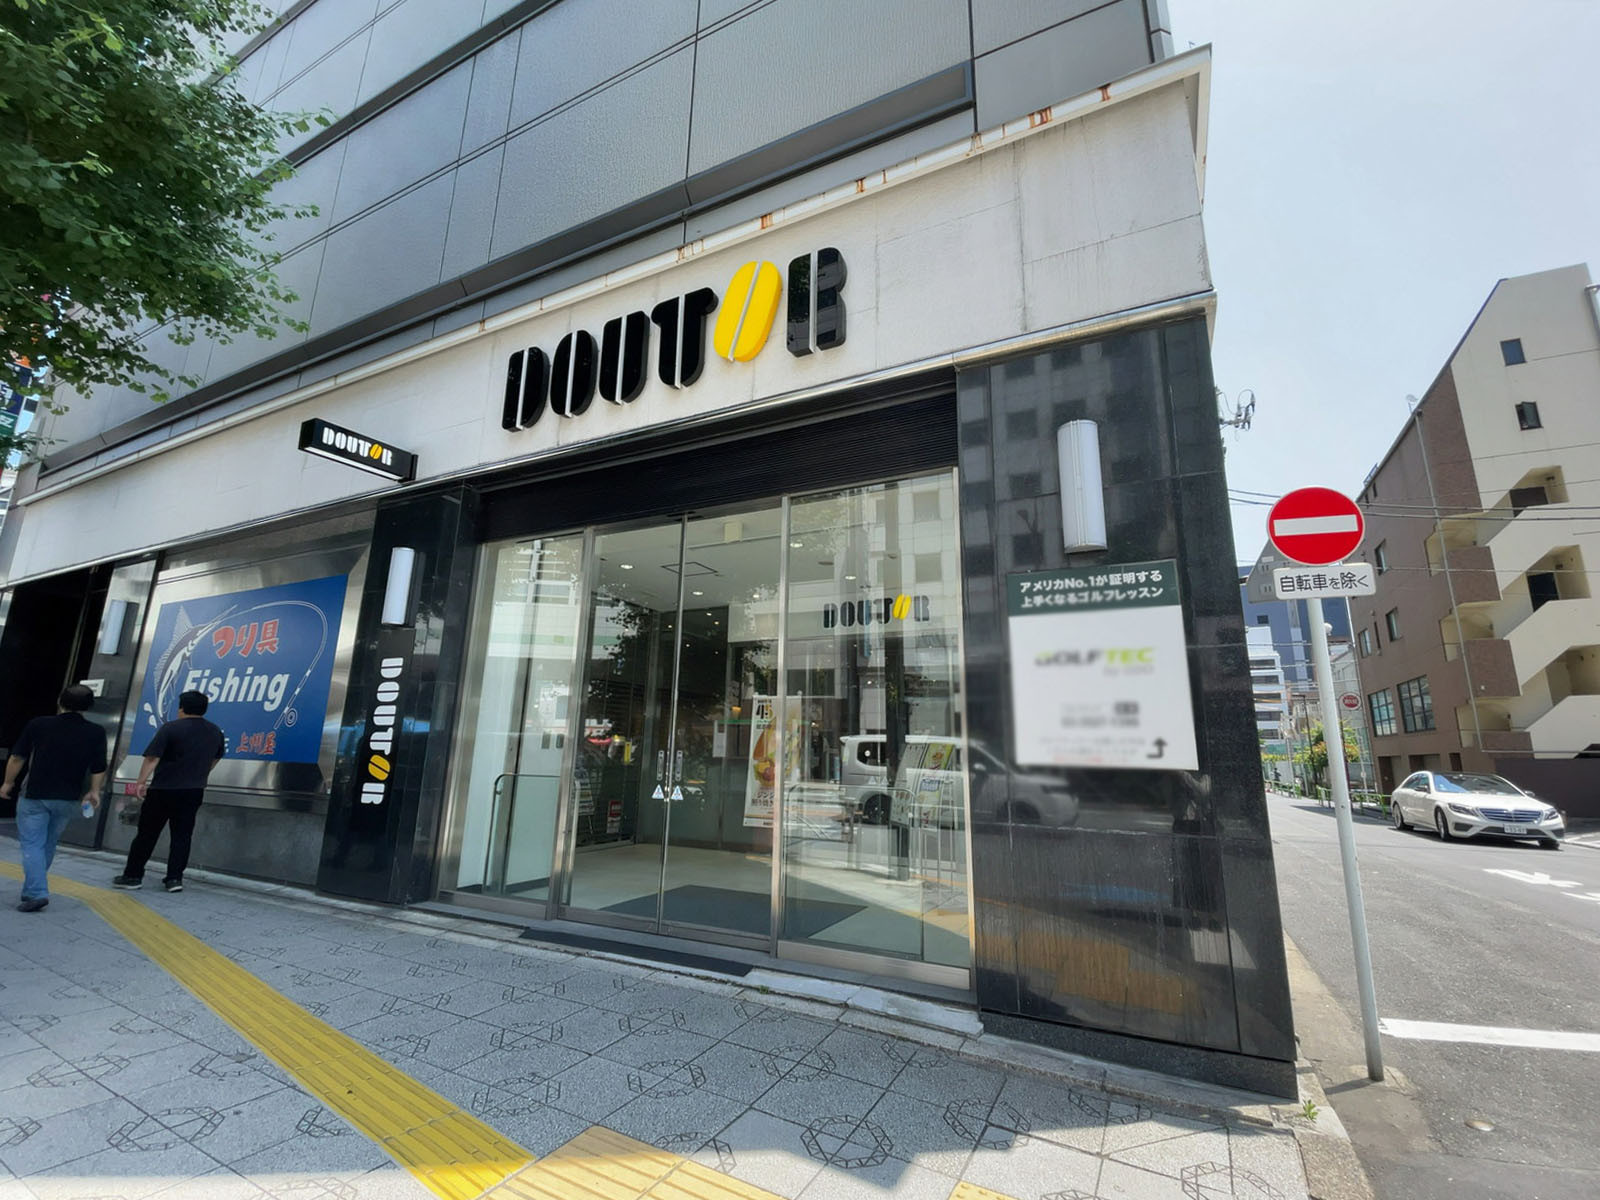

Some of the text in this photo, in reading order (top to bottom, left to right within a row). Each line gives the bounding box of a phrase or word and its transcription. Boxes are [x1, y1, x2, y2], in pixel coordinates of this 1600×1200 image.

[501, 246, 848, 433] DOUTOR
[322, 426, 393, 466] DOUTOR
[1020, 569, 1163, 593] アメリカNo.1が証明する
[1021, 586, 1164, 608] 上手くなるゴルフレッスン
[1280, 571, 1369, 593] 自転車を除く
[823, 593, 930, 629] DOUTOR
[213, 619, 280, 659] つり具
[182, 666, 290, 712] Fishing
[236, 731, 277, 755] 上州屋
[360, 657, 404, 805] DOUTOR
